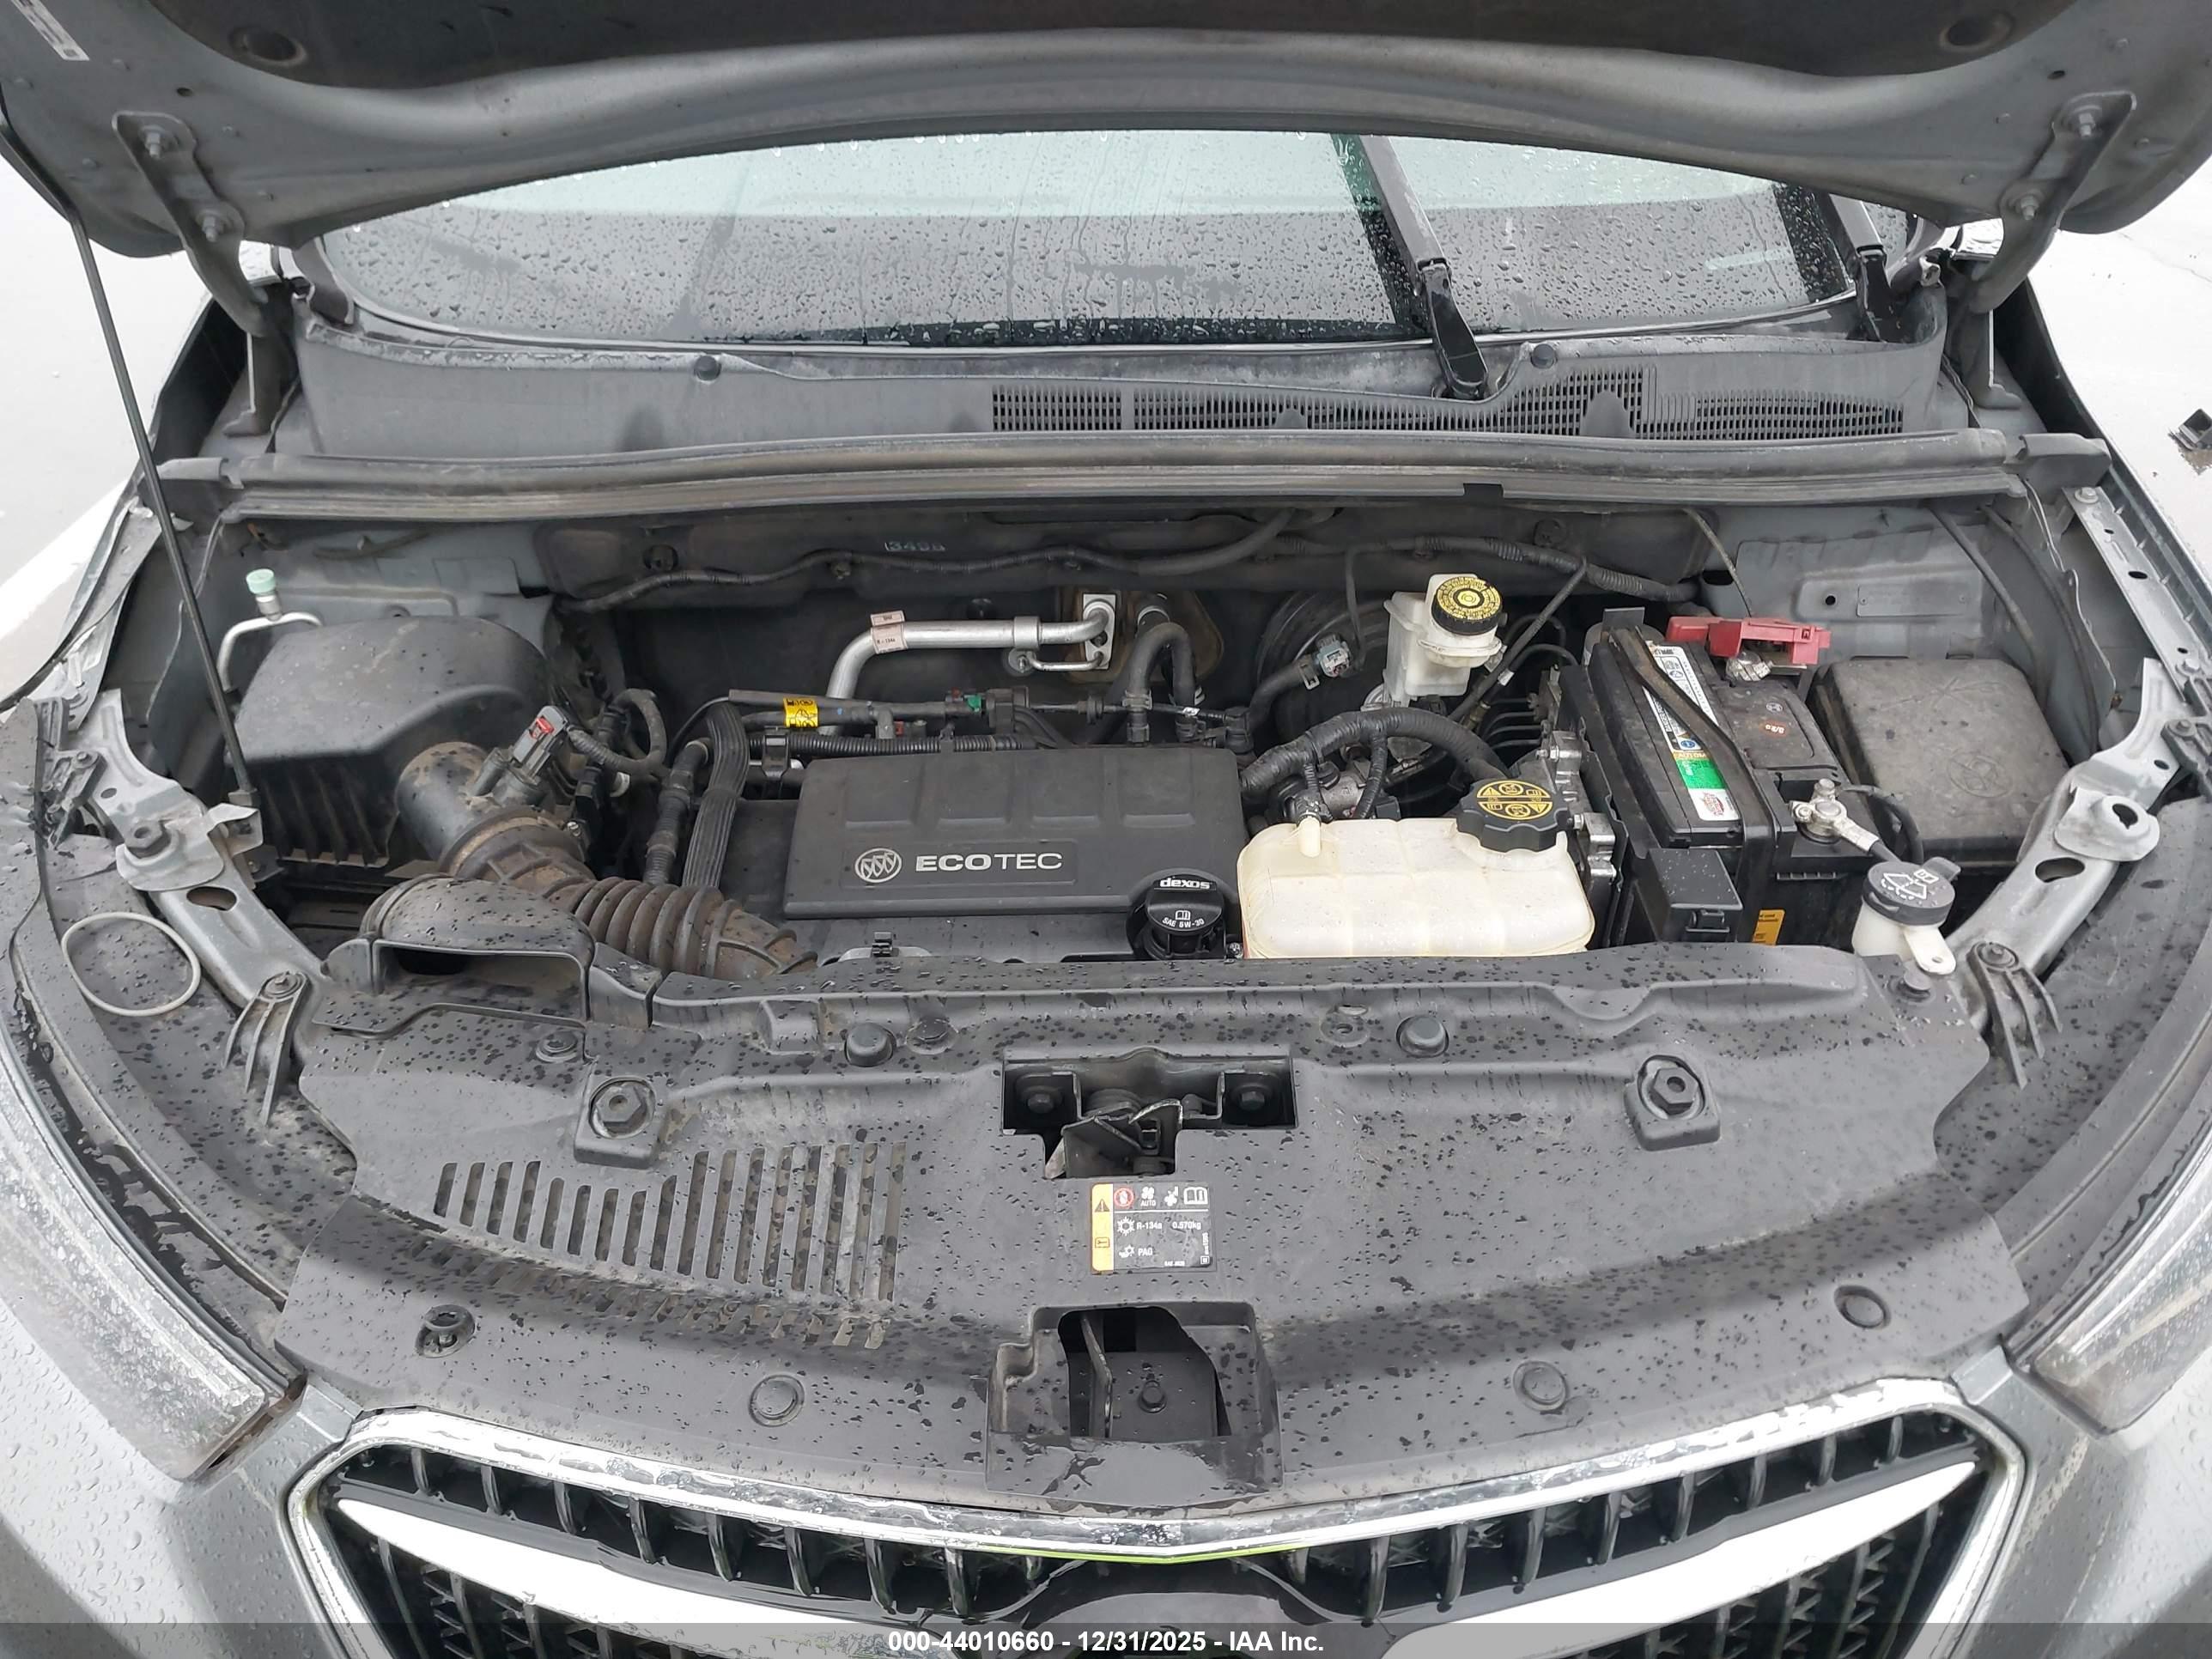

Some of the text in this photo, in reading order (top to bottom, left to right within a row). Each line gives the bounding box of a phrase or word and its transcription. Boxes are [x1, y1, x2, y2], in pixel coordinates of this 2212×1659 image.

[915, 853, 1062, 872] ECOTEC
[1159, 877, 1210, 890] dexos
[1162, 916, 1205, 928] SAE 5W-30
[1172, 1221, 1201, 1231] 0.570kg
